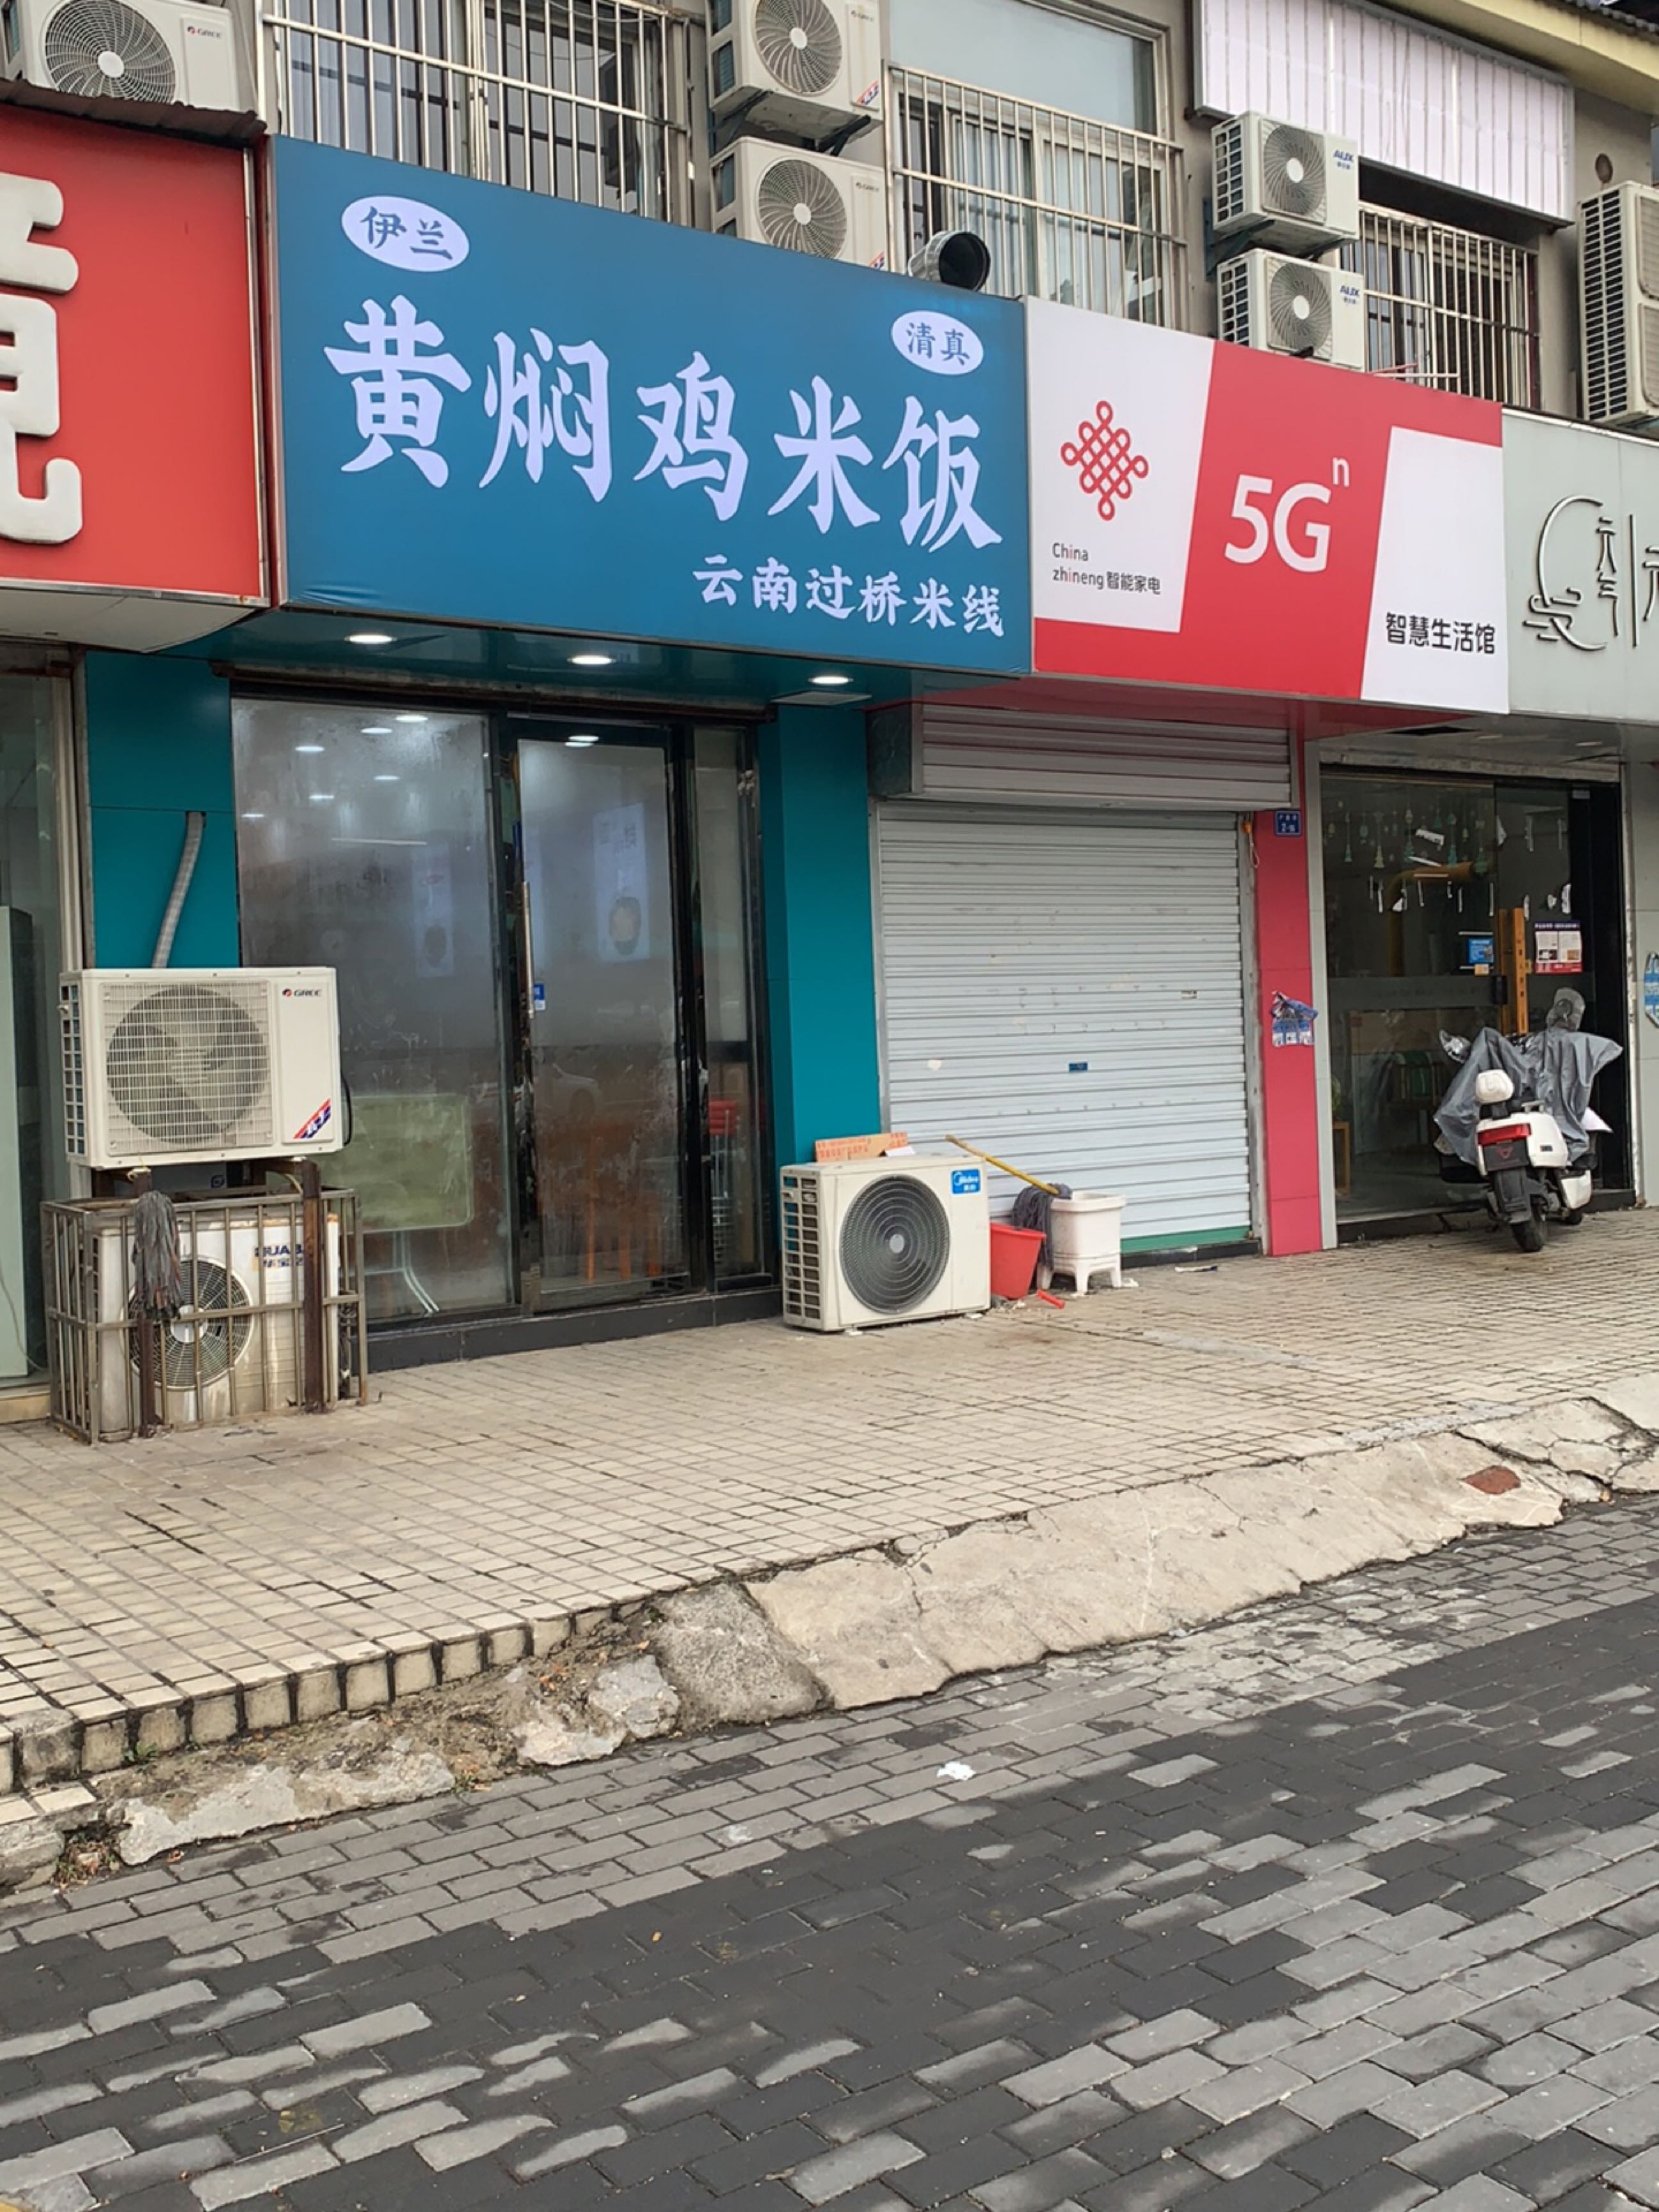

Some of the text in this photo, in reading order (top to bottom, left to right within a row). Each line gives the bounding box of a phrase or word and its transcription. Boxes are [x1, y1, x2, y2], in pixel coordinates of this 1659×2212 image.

[360, 205, 453, 260] 伊兰
[906, 322, 970, 365] 清真
[324, 294, 1002, 552] 黄焖鸡米饭
[1052, 542, 1088, 561] China
[692, 554, 1004, 637] 云南过桥米线
[1107, 571, 1161, 595] 智能家电
[1386, 612, 1495, 654] 智慧生活馆
